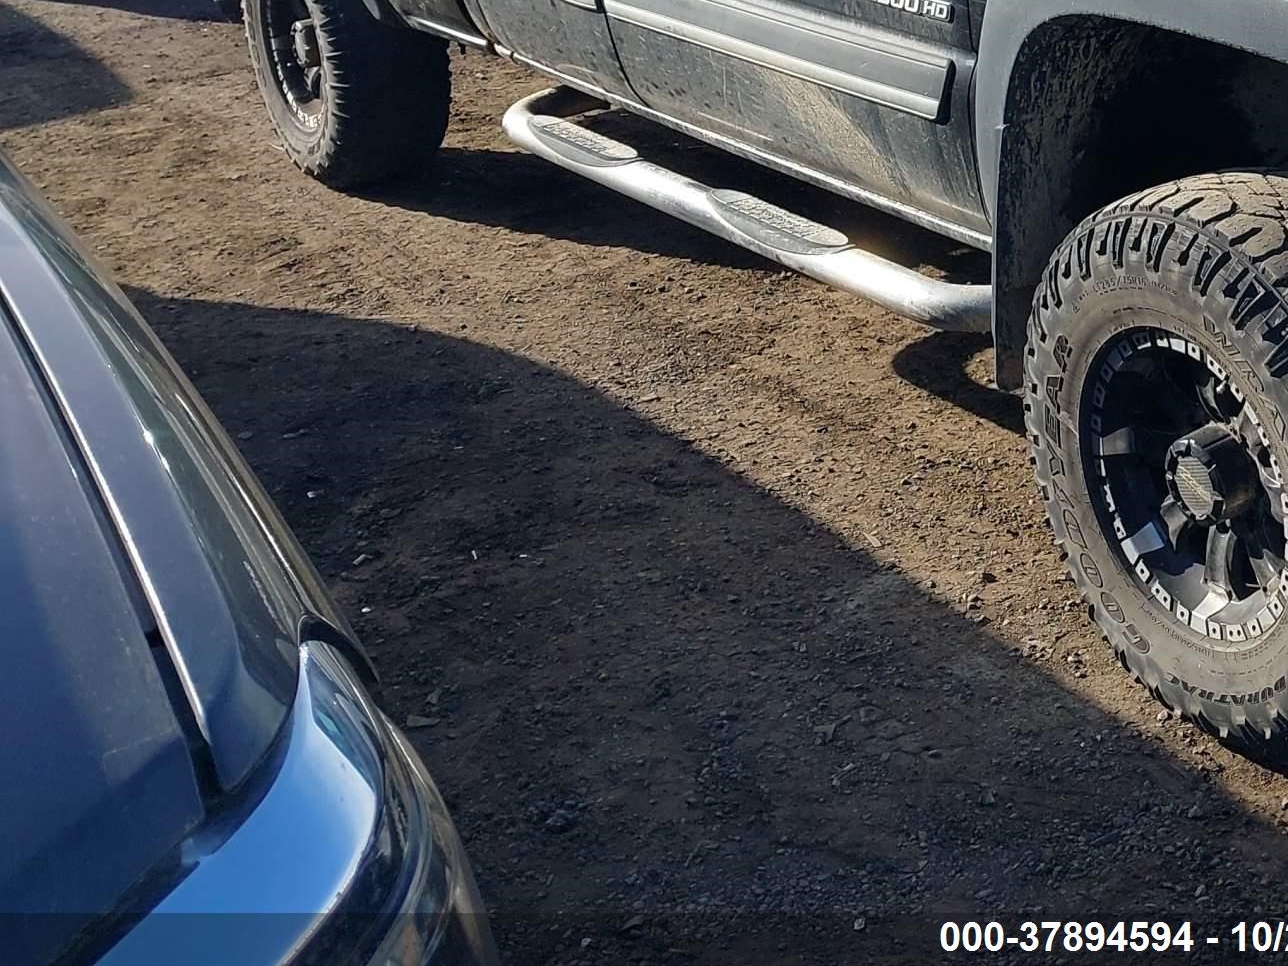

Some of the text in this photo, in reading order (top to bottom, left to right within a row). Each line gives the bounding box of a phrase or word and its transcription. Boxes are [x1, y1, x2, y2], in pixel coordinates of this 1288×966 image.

[922, 0, 949, 19] HD
[1045, 334, 1151, 655] GOODYEAR
[1164, 672, 1287, 707] DURATRAC
